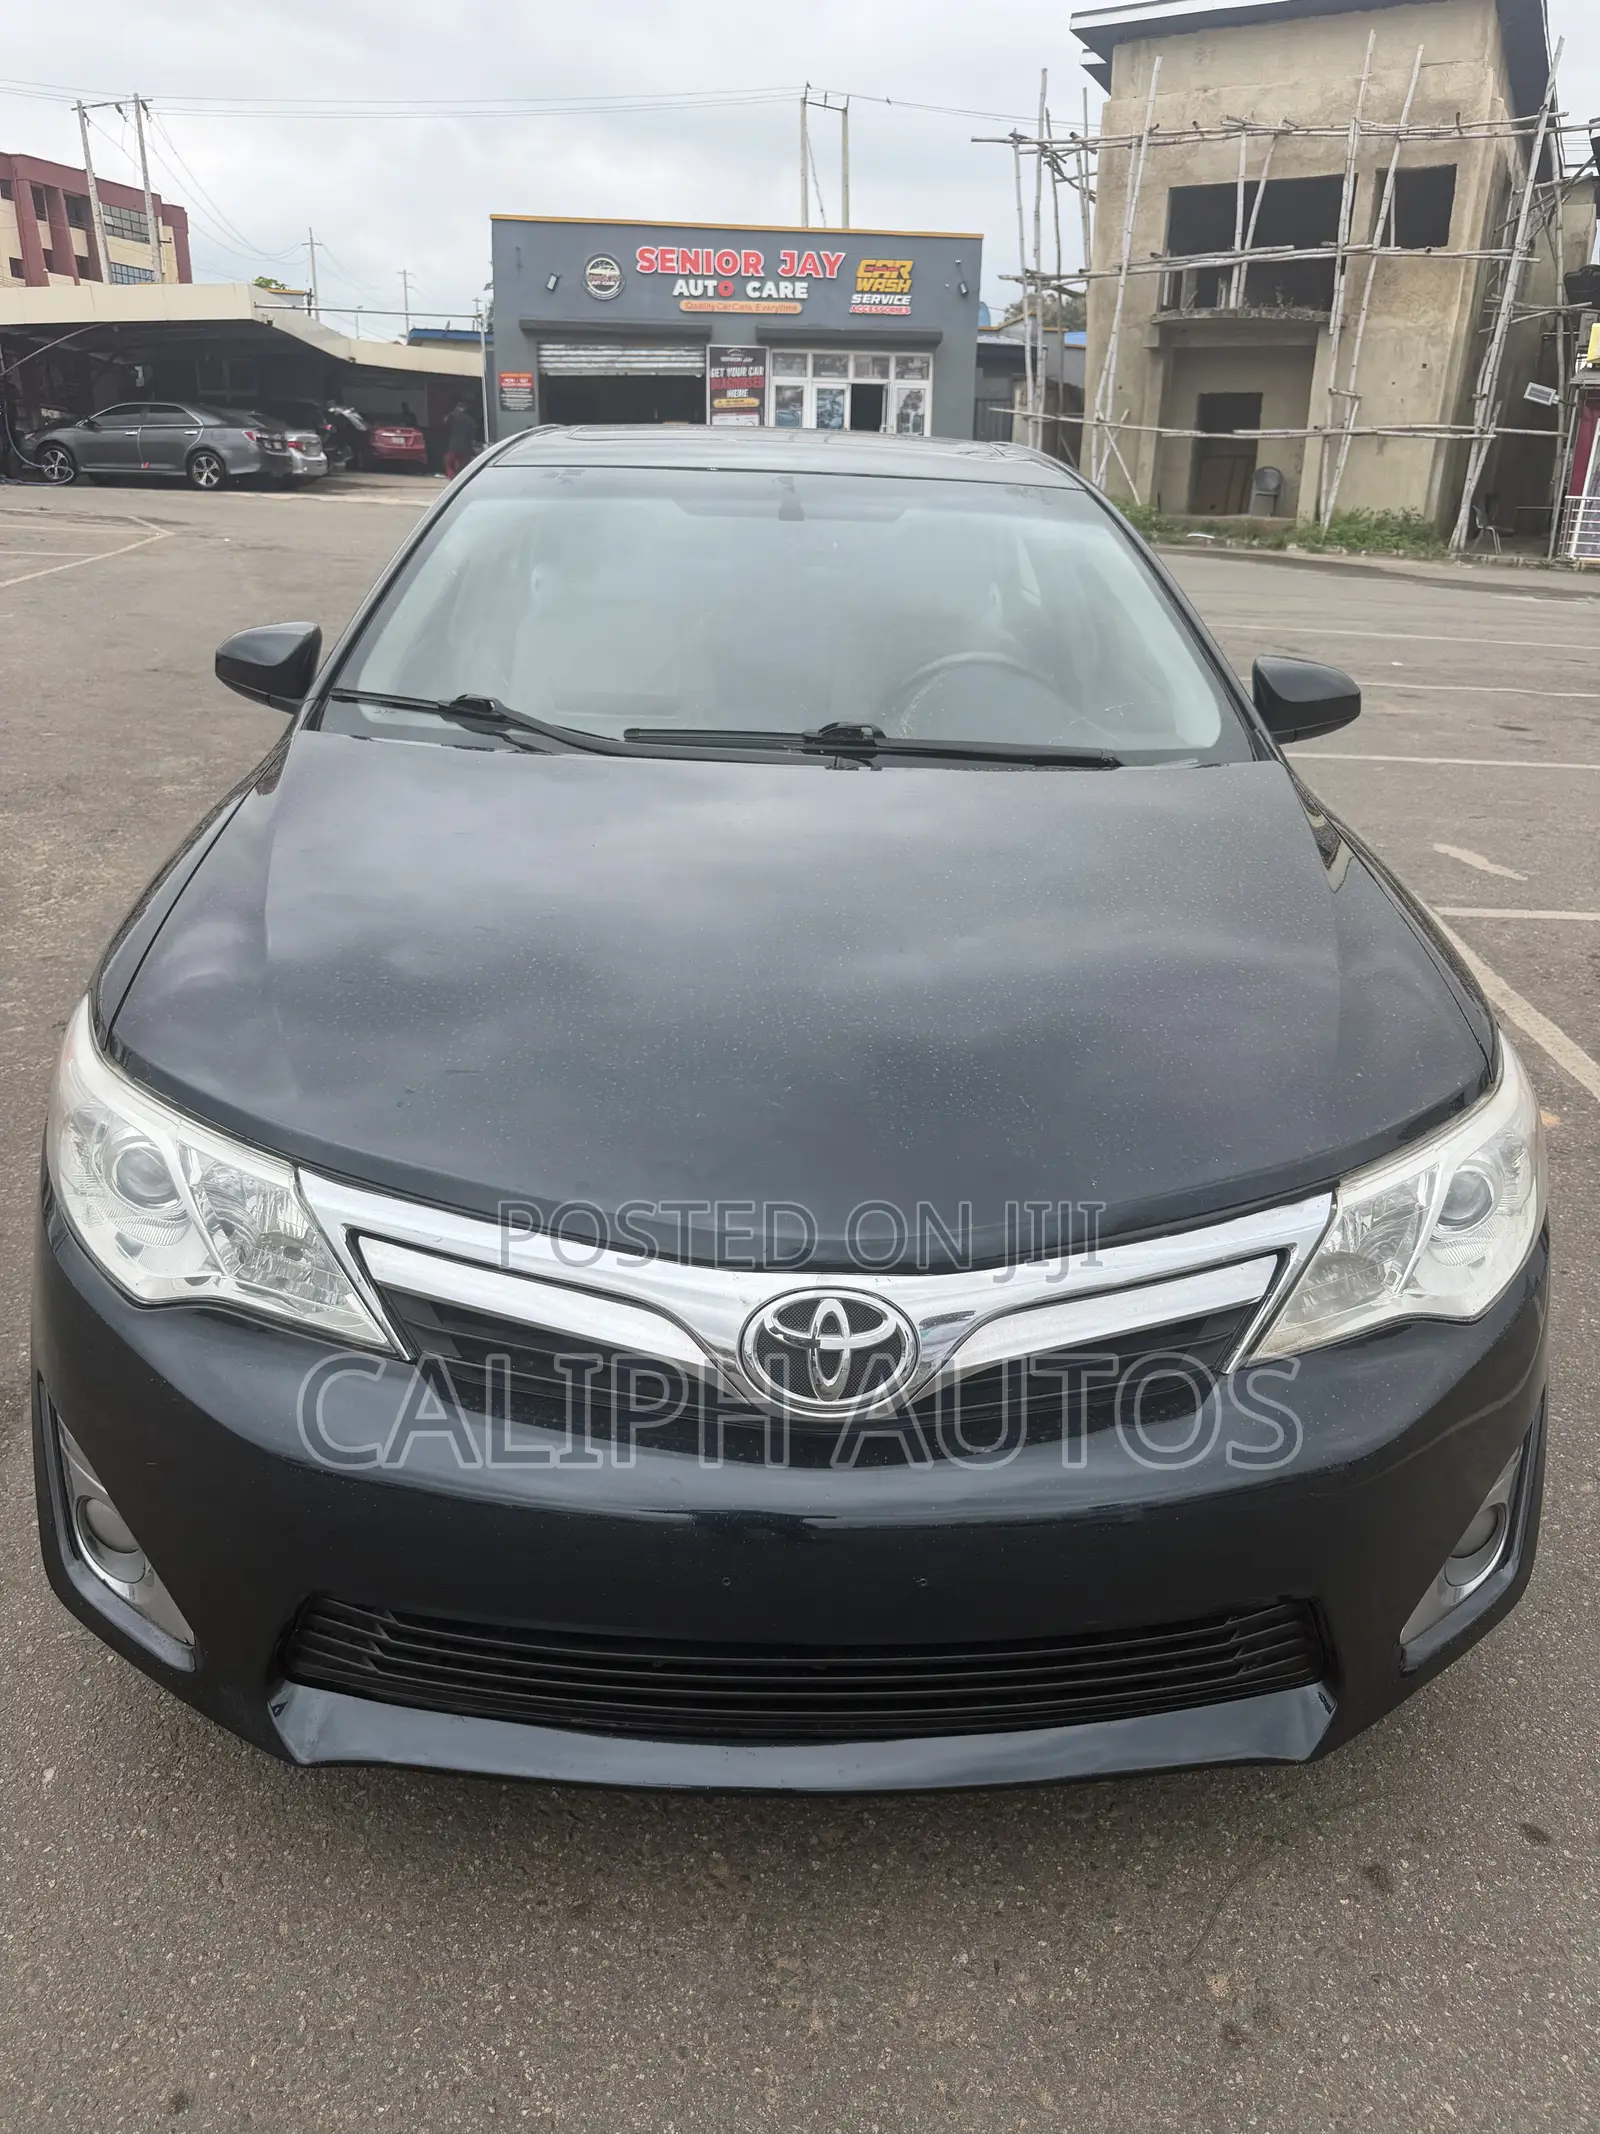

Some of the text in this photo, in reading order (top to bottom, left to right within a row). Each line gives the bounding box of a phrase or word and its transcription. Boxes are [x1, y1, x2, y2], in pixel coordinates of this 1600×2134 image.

[636, 246, 847, 279] SENIOR JAY
[856, 259, 914, 279] CAR
[672, 279, 809, 300] AUTO CARE
[856, 278, 912, 293] WASH
[851, 293, 912, 305] SERVICE
[685, 301, 715, 312] Quality
[849, 304, 912, 315] ACCESSORIES
[711, 365, 765, 378] GET YOUR CAR
